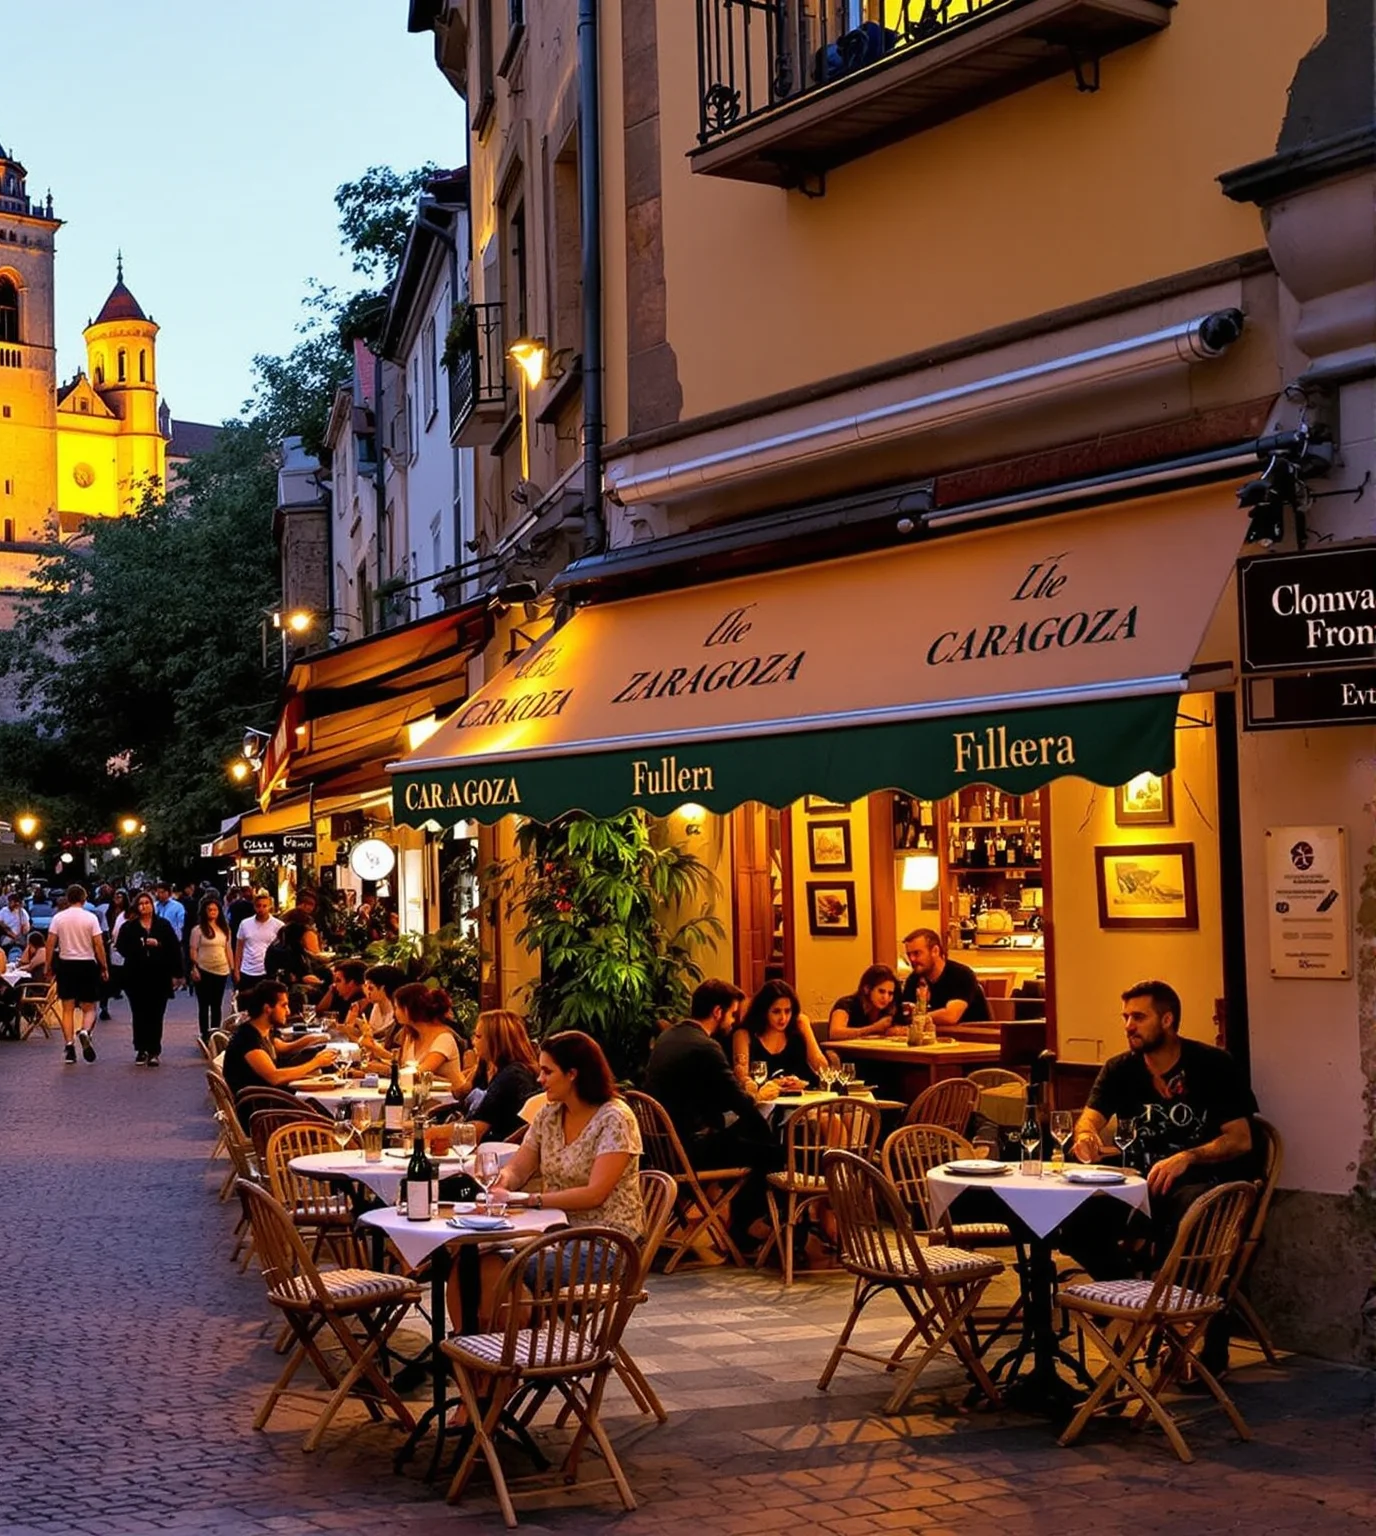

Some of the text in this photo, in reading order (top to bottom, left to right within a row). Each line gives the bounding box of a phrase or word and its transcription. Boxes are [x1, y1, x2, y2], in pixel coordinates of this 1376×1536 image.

[926, 605, 1138, 665] CARAGOZA
[1306, 618, 1376, 649] Fron
[611, 651, 806, 704] ZARAGOZA
[405, 777, 521, 811] CARAGOZA
